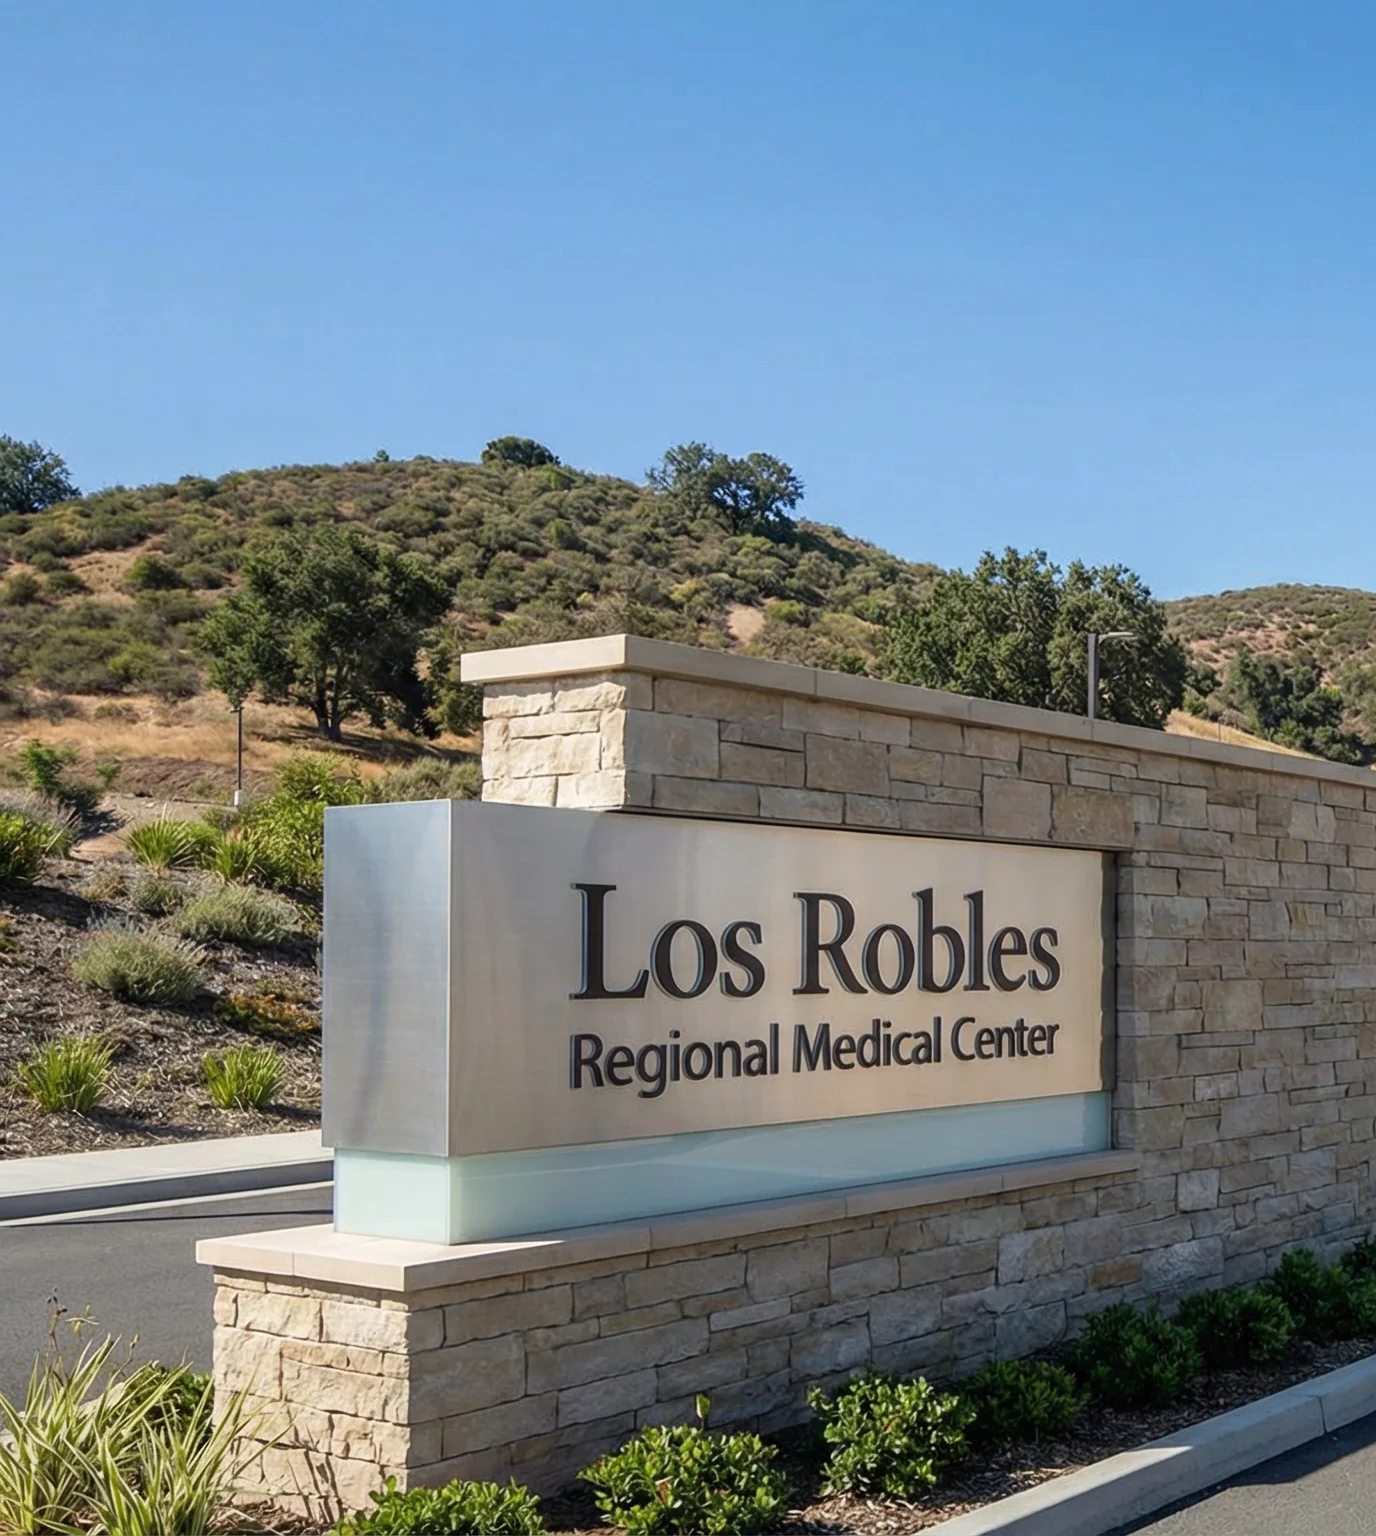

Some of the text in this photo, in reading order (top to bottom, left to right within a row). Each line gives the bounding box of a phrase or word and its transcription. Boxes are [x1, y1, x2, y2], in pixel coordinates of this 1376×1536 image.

[568, 882, 1062, 1001] Los Robles
[568, 1015, 1060, 1099] Regional Medical Center
